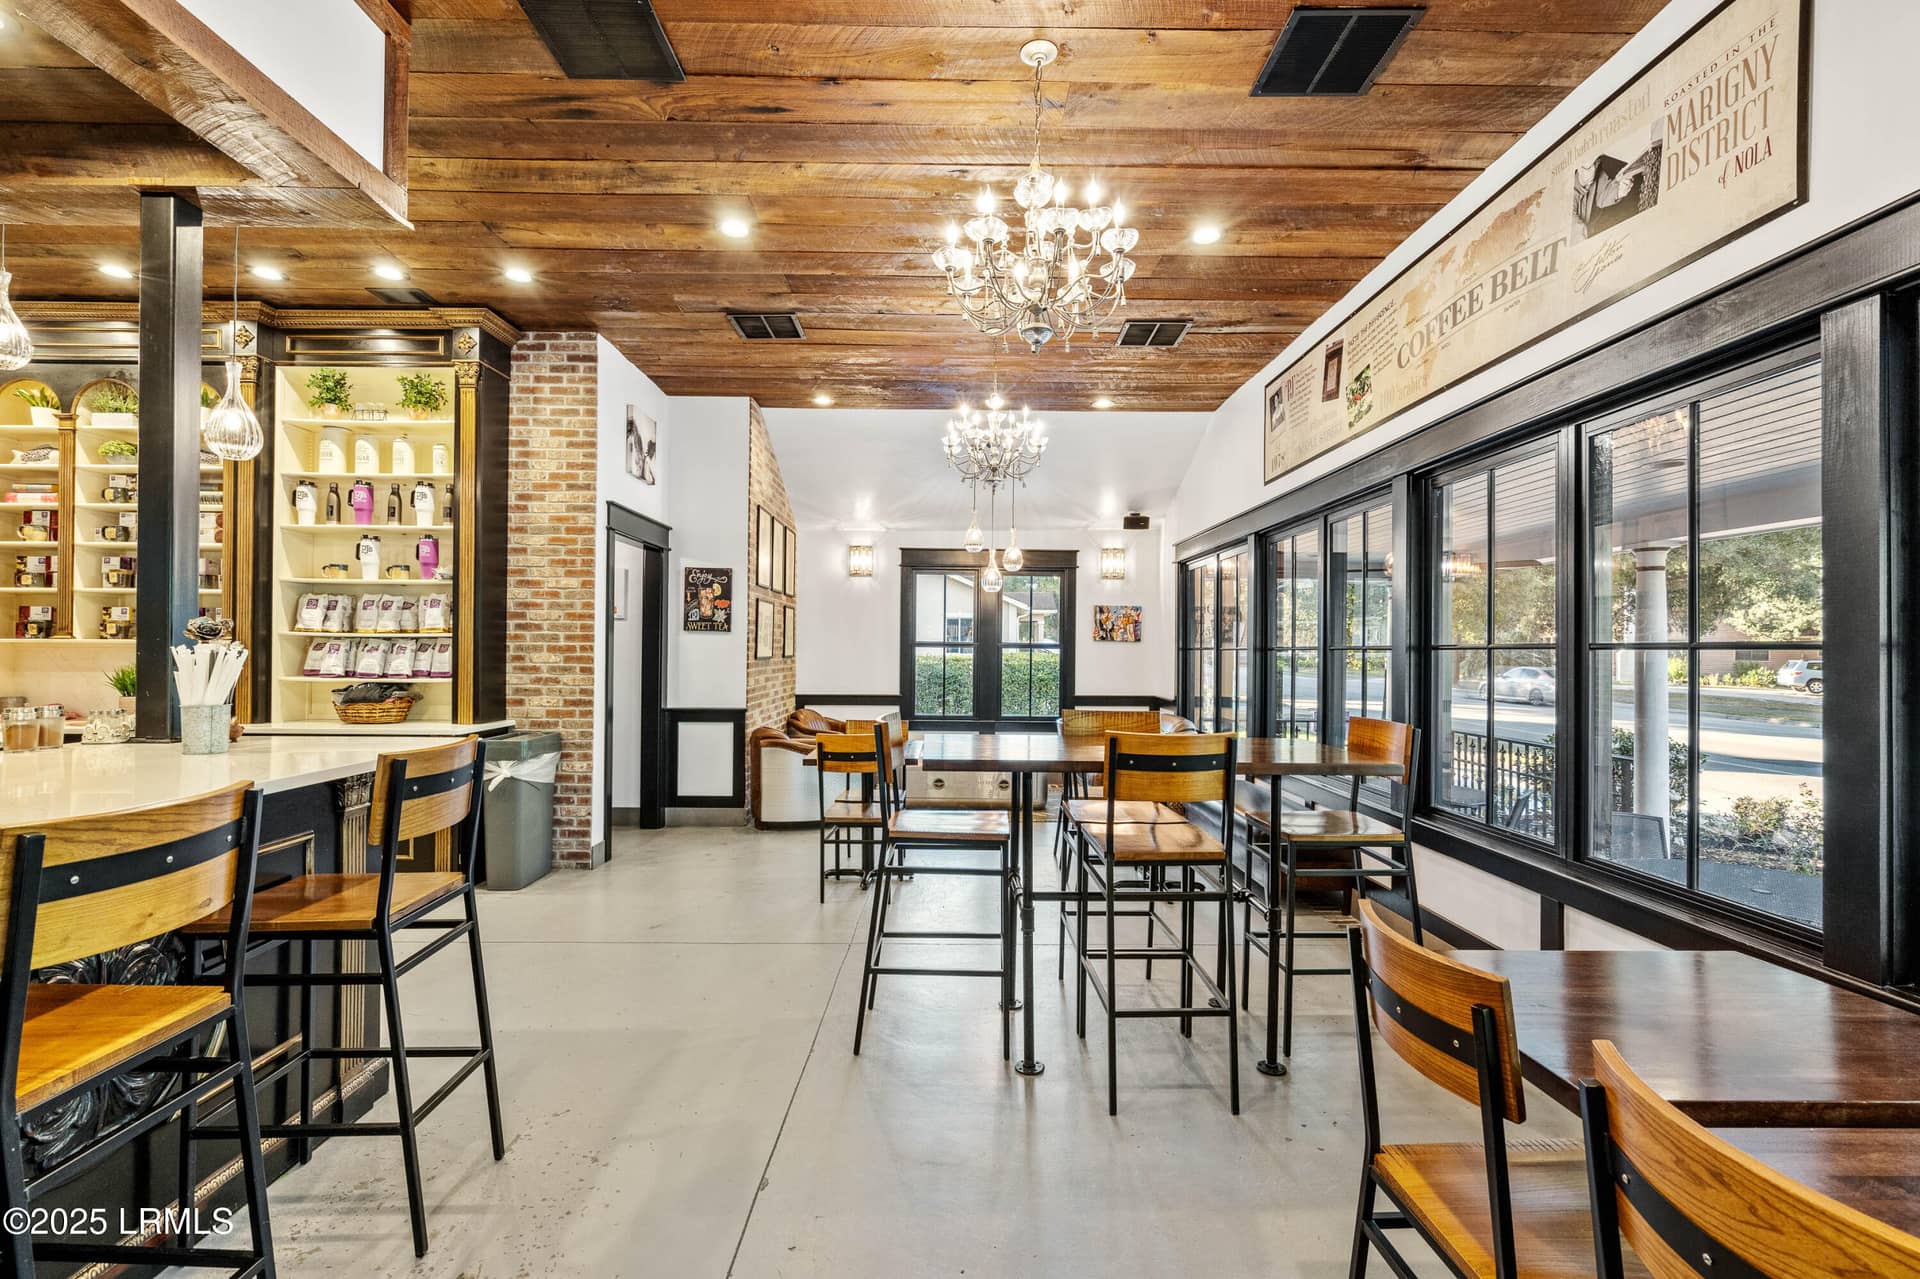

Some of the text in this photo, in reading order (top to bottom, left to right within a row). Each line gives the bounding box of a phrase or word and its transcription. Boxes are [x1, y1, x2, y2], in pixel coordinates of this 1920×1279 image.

[1663, 17, 1776, 108] ROASTED IN THE
[1666, 34, 1779, 152] MARIGNY
[1666, 85, 1774, 192] DISTRICT
[1734, 136, 1772, 178] NOLA
[1397, 283, 1484, 369] COFFEE
[1490, 237, 1567, 305] BELT
[688, 568, 728, 585] Enjoy
[687, 621, 729, 632] SWEET TEA
